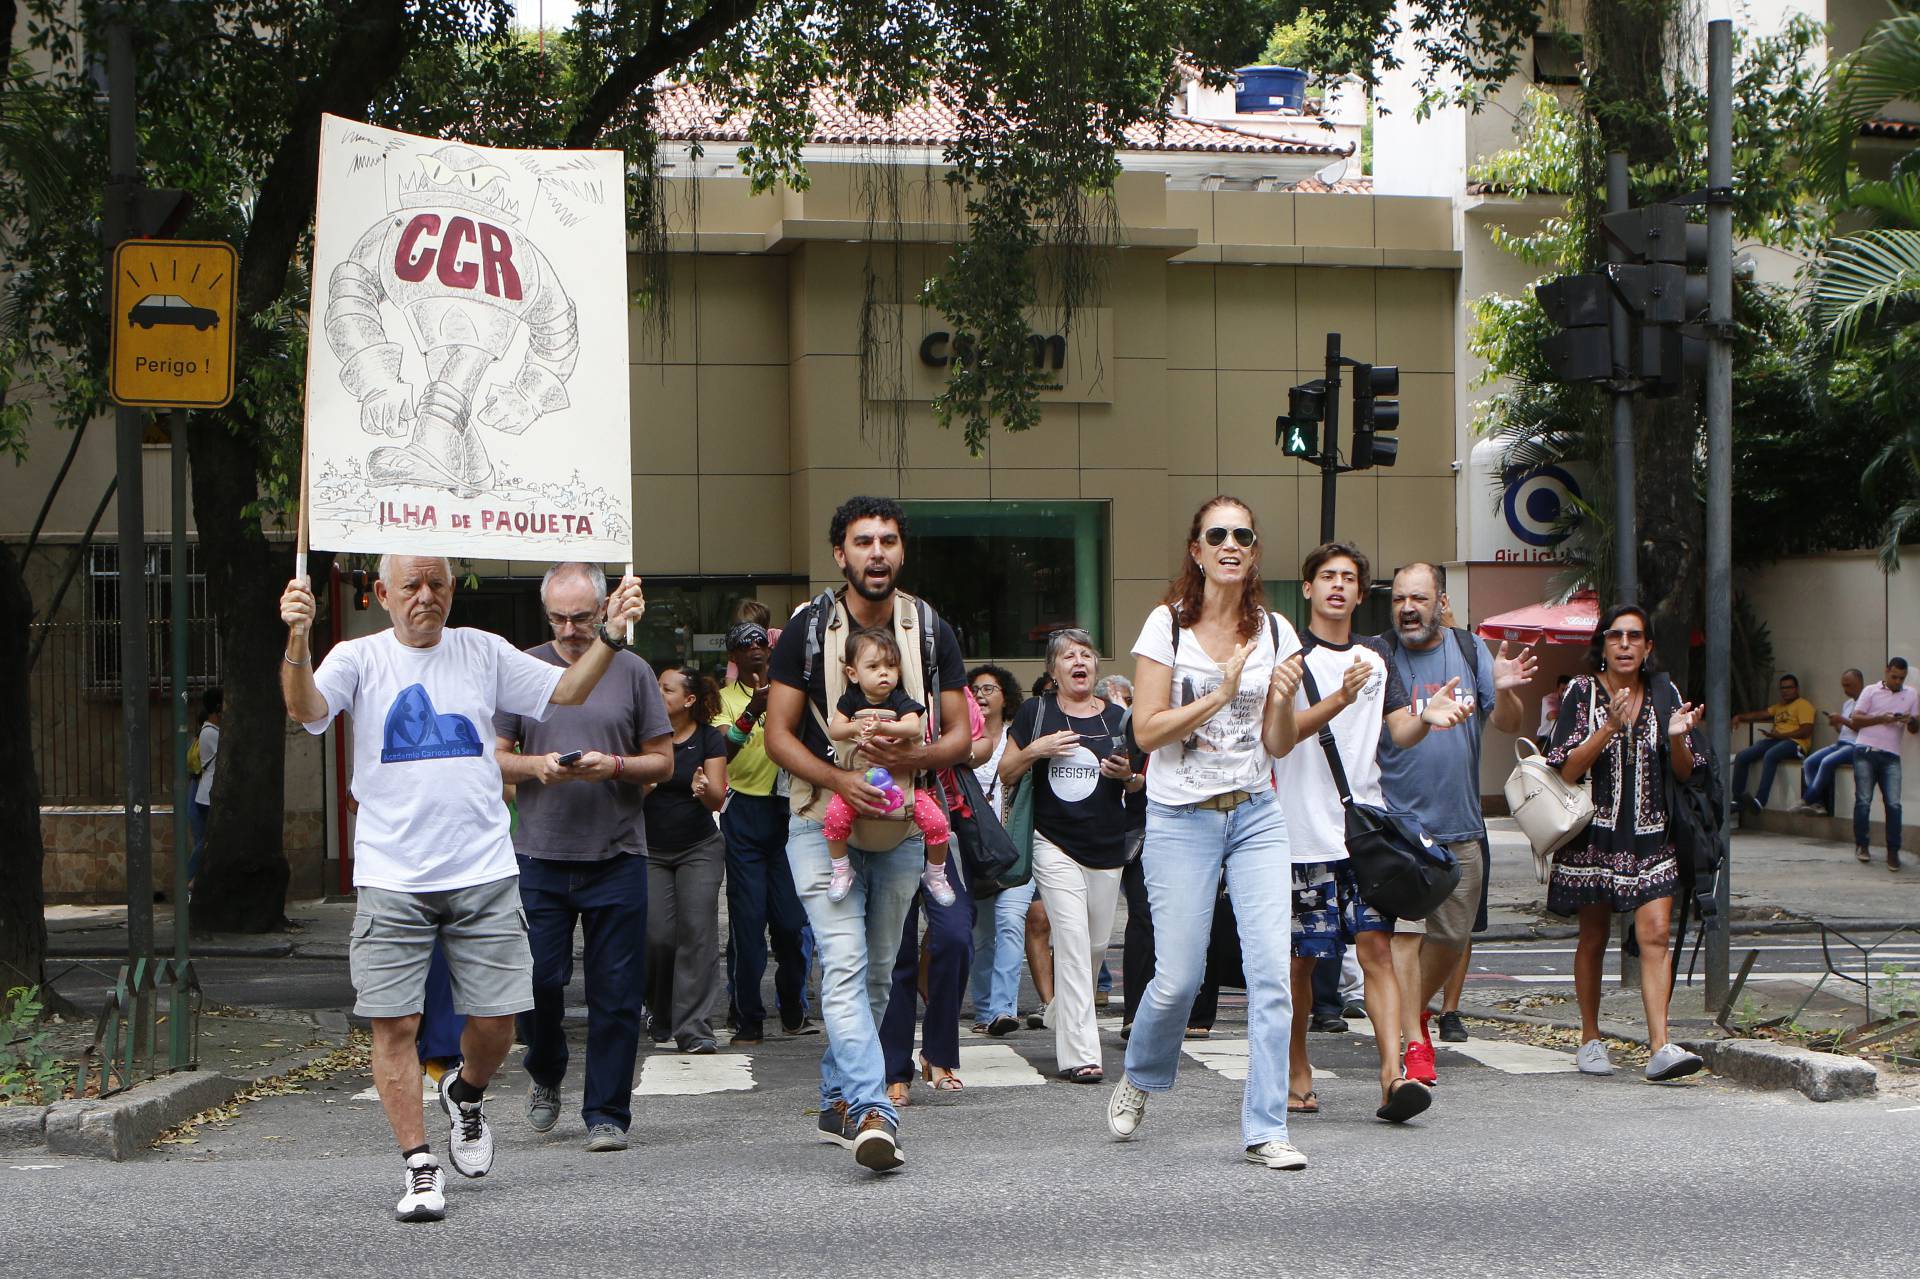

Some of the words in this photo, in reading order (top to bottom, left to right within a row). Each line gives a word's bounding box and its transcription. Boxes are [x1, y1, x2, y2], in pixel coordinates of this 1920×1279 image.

[394, 213, 523, 301] CCR
[919, 331, 1066, 369] csm
[135, 356, 197, 377] Perigo
[379, 501, 437, 526] ILHA
[451, 514, 471, 528] DE
[481, 510, 594, 535] PAQUETÁ
[1495, 548, 1520, 561] Air
[1051, 766, 1096, 779] RESISTA
